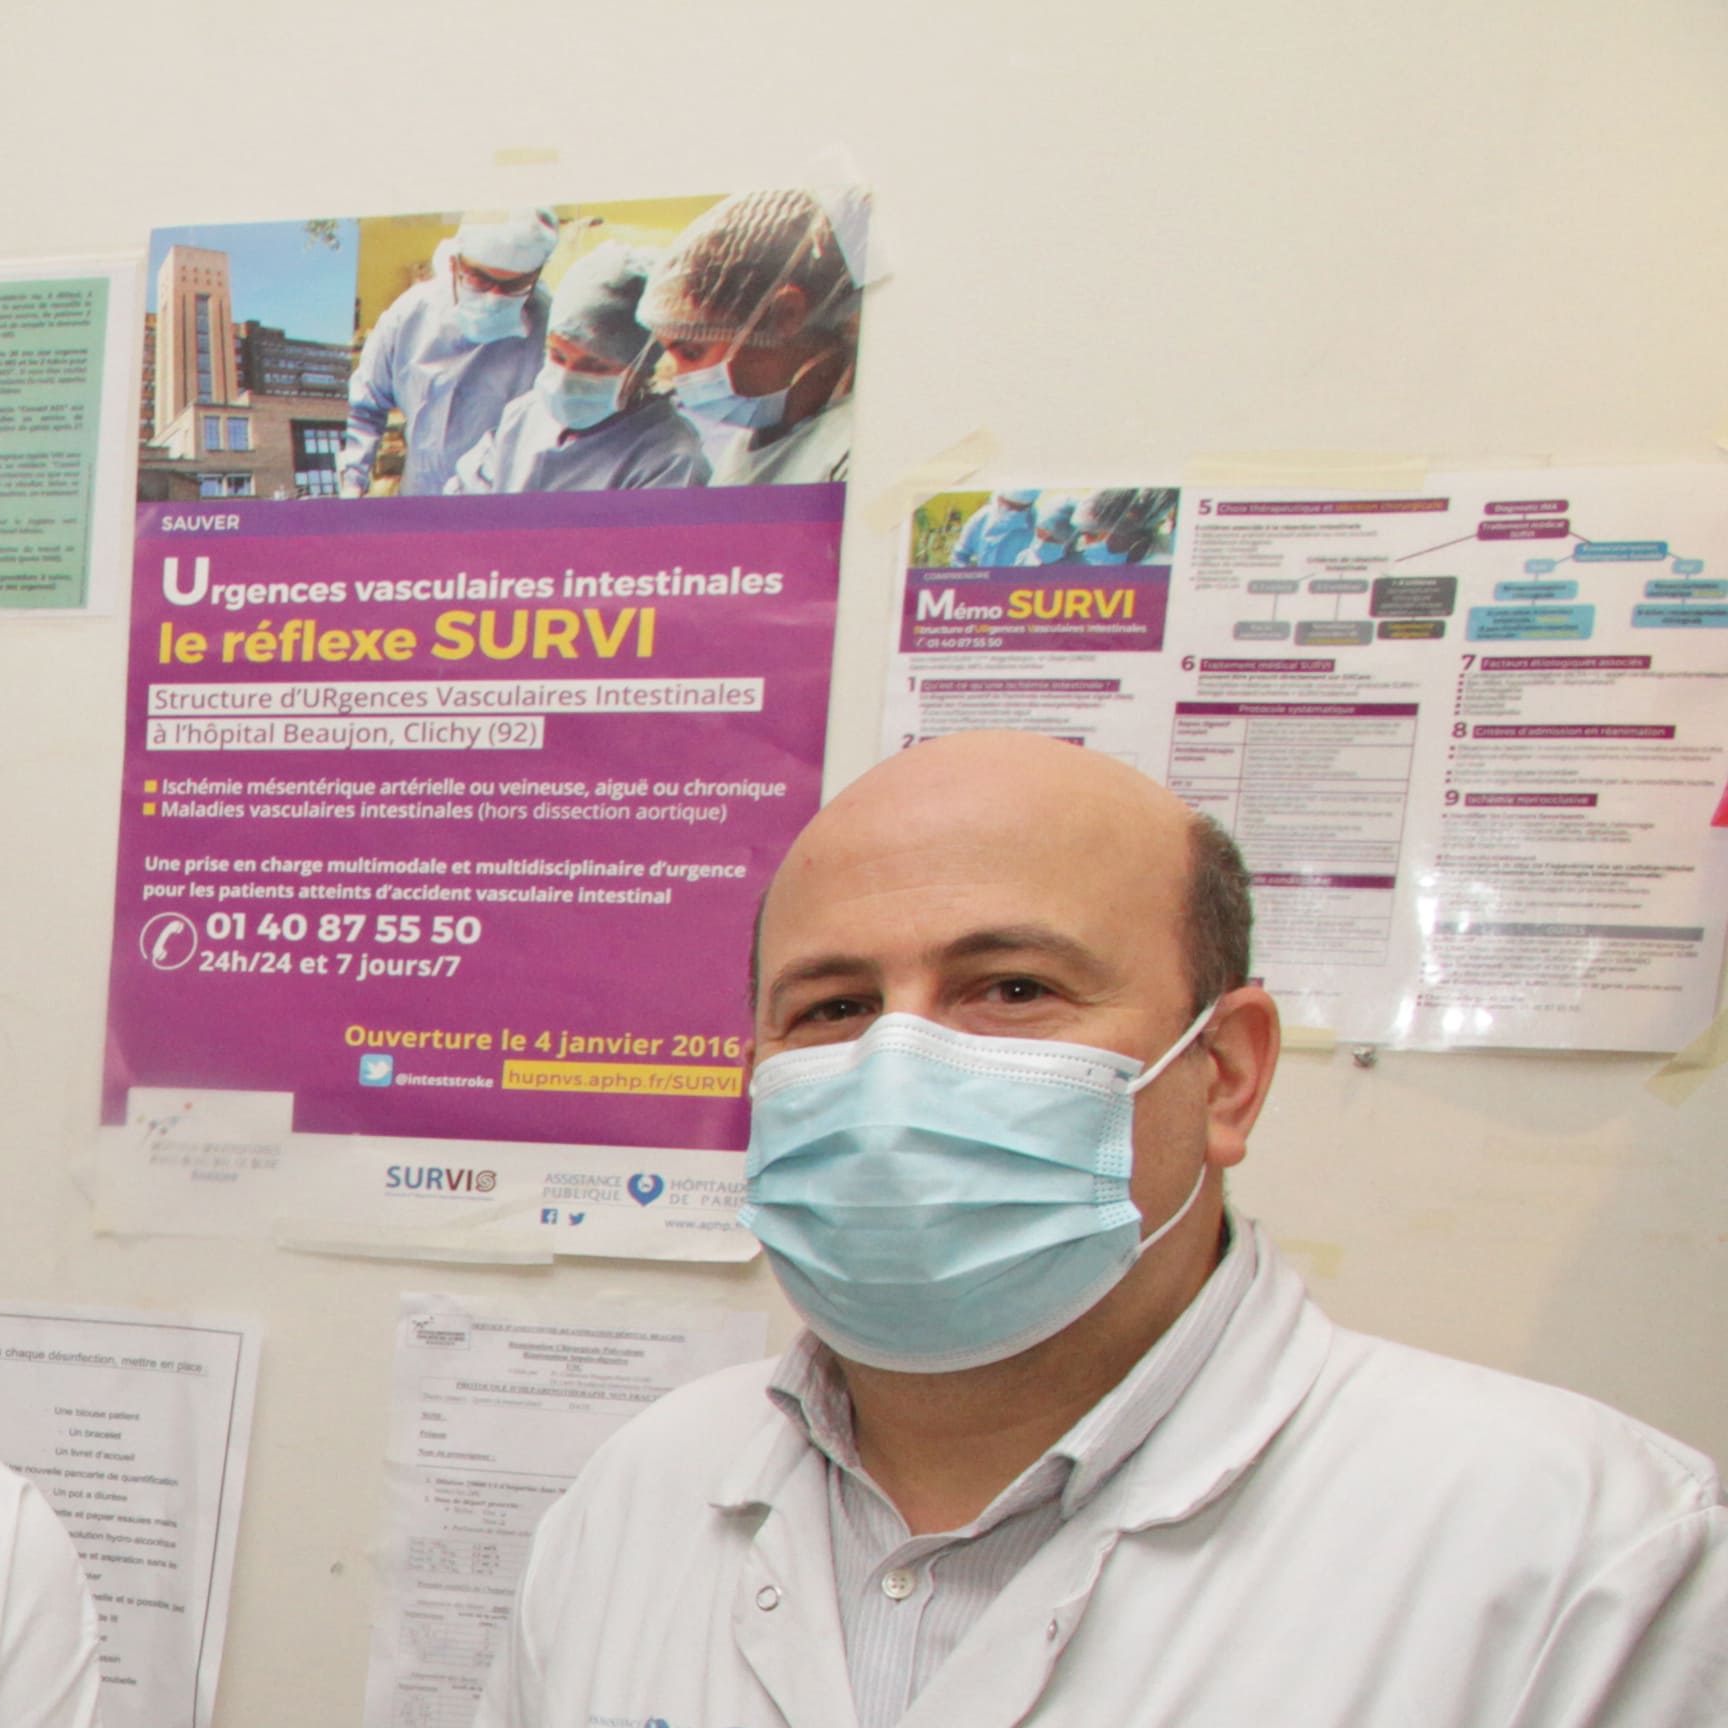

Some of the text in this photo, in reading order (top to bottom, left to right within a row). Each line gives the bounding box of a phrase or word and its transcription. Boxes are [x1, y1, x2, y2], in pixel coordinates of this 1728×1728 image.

[1198, 500, 1212, 514] 5
[161, 515, 240, 530] SAUVER
[162, 556, 784, 611] Urgences vasculaires intestinales
[917, 588, 1135, 621] Mémo SURVI
[159, 607, 656, 663] le réflexe SURVI
[914, 626, 963, 634] Structure
[1028, 624, 1084, 634] Vasculaires
[1086, 624, 1146, 633] Intestinales
[942, 640, 956, 648] 40
[958, 639, 972, 648] 87
[973, 639, 986, 648] 55
[988, 638, 1002, 648] 50
[1181, 656, 1196, 671] 6
[1462, 655, 1475, 670] 7
[908, 677, 916, 692] 1
[155, 684, 756, 713] Structure d'URgences Vasculaires Intestinales
[1240, 704, 1355, 714] Protocole systématique
[154, 722, 537, 750] à l'hôpital Beaujon, Clichy (92)
[1452, 722, 1467, 738] 8
[902, 734, 914, 749] 2
[162, 779, 242, 795] Ischémie
[247, 779, 375, 799] mésentérique
[380, 778, 466, 795] artérielle
[470, 783, 494, 796] ou
[499, 779, 590, 797] veineuse,
[653, 783, 678, 796] ou
[684, 779, 786, 800] chronique
[1445, 790, 1459, 805] 9
[161, 801, 727, 824] Maladies vasculaires intestinales (hors dissection aortique)
[145, 856, 746, 881] Une prise en charge multimodale et multidisciplinaire d'urgence
[143, 882, 672, 904] pour les patients atteints d'accident vasculaire intestinal
[206, 912, 482, 944] 01 40 87 55 50
[199, 951, 461, 981] 24h/24 et 7 jours/7
[345, 1025, 741, 1058] Ouverture le 4 janvier 2016
[396, 1069, 737, 1094] @inteststroke hupnvs.aphp.fr/SURVI
[544, 1173, 621, 1187] ASSISTANCE
[543, 1186, 689, 1206] PUBLIQUE DE
[5, 1347, 45, 1360] chaque
[48, 1351, 117, 1366] désinfection,
[121, 1357, 157, 1368] mettre
[160, 1361, 174, 1369] en
[177, 1362, 203, 1373] place
[54, 1407, 140, 1421] Une blouse patient
[69, 1428, 122, 1440] Un bracelet
[55, 1447, 93, 1457] Un livret
[25, 1465, 179, 1486] nouvelle pancarte de quantification
[53, 1487, 83, 1500] Un pot
[76, 1511, 114, 1521] et papier
[101, 1554, 145, 1565] aspiration
[147, 1558, 166, 1567] sans
